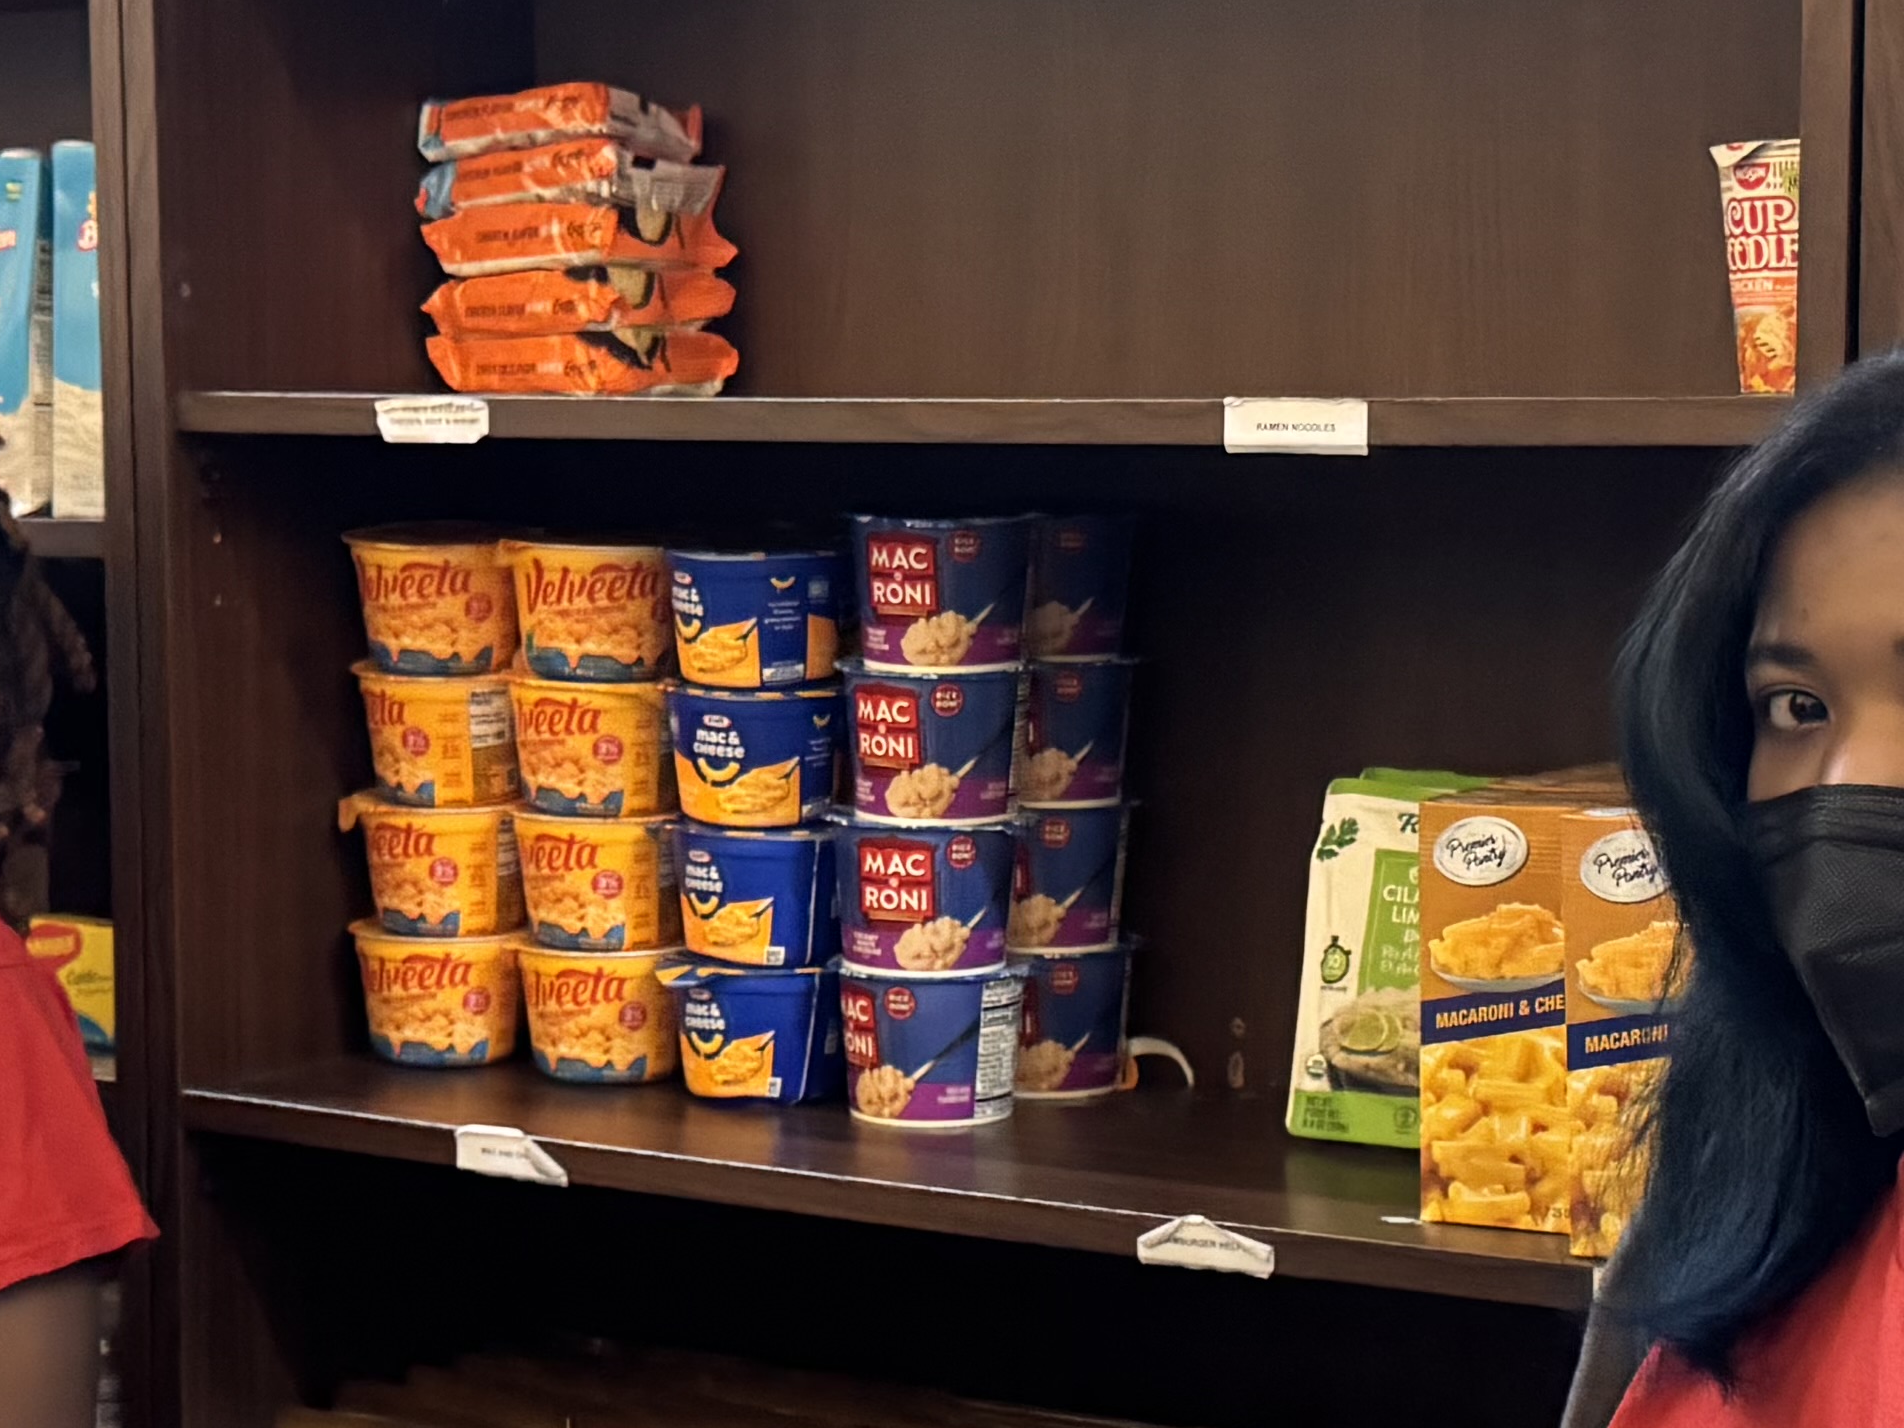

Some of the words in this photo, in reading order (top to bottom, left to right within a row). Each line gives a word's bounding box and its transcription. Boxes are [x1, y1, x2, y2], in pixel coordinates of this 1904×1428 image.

[1728, 199, 1795, 235] CUP
[1256, 423, 1289, 431] RAMEN
[1292, 423, 1336, 432] NOODLES
[871, 548, 928, 569] MAC
[526, 559, 659, 614] Velveeta
[873, 583, 931, 605] RONI
[858, 701, 910, 722] MAC
[697, 729, 726, 744] mac
[727, 731, 739, 745] &
[860, 736, 914, 758] RONI
[693, 742, 744, 758] cheese
[864, 854, 924, 876] MAC
[865, 887, 927, 910] RONI
[1383, 885, 1419, 902] CILA
[1392, 907, 1419, 923] LIM
[1436, 1001, 1513, 1029] MACARONI
[1518, 1000, 1529, 1016] &
[1535, 993, 1564, 1014] CHE
[1585, 1024, 1668, 1053] MACARONI
